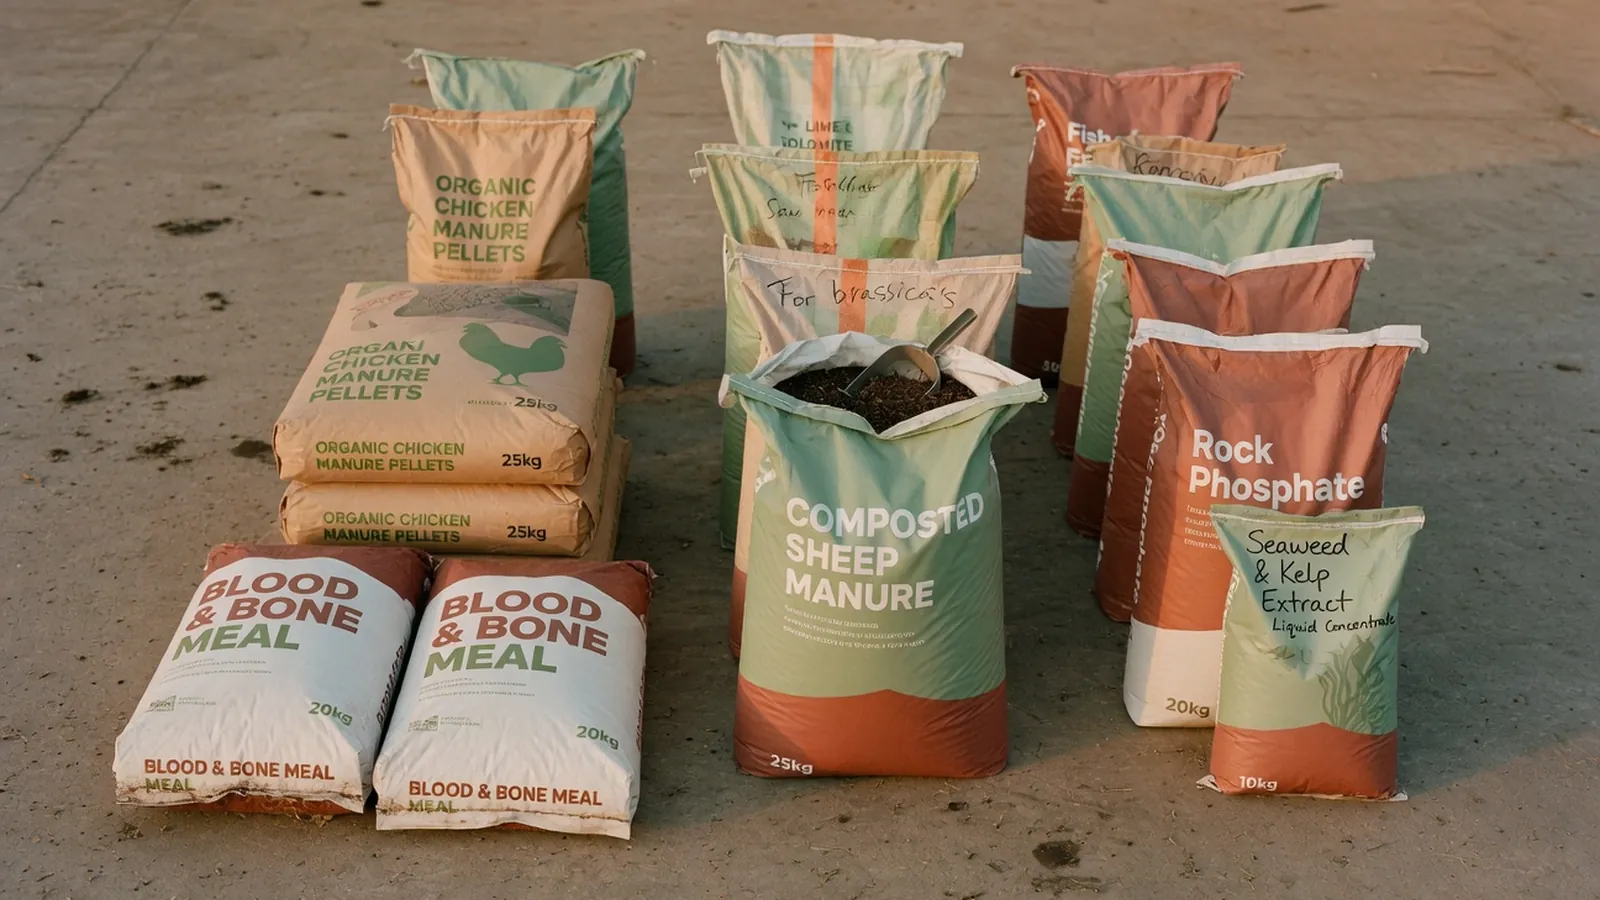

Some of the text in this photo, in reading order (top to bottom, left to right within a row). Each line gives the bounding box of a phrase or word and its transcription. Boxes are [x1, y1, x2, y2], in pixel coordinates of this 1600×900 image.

[1068, 121, 1111, 143] Fish
[436, 175, 536, 196] ORGANIC
[435, 197, 533, 218] CHICKEN
[434, 220, 529, 240] MANURE
[433, 242, 525, 263] PELLETS
[767, 276, 816, 308] For
[323, 353, 441, 373] CHICKEN
[316, 368, 430, 387] MANURE
[309, 385, 423, 403] PELLETS
[316, 441, 465, 456] ORGANIC CHICKEN
[1192, 429, 1274, 465] Rock
[316, 458, 455, 472] MANURE PELLETS
[502, 454, 542, 469] 25kg
[1188, 465, 1365, 509] Phosphate
[323, 511, 471, 527] ORGANIC CHICKEN
[786, 492, 984, 539] COMPOSTED
[324, 529, 460, 543] MANURE PELLETS
[507, 526, 546, 541] 25kg
[1246, 529, 1350, 555] Seaweed
[786, 533, 899, 576] SHEEP
[1254, 558, 1330, 592] & Kelp
[199, 572, 359, 606] BLOOD
[785, 568, 935, 611] MANURE
[440, 590, 602, 622] BLOOD
[1262, 588, 1353, 613] Extract
[185, 597, 363, 634] & BONE
[432, 616, 609, 657] & BONE
[1272, 617, 1318, 639] Liquid
[172, 623, 300, 662] MEAL
[423, 643, 558, 679] MEAL
[1165, 697, 1210, 718] 20kg
[576, 725, 619, 750] 20kg
[144, 758, 335, 780] BLOOD & BONE MEAL
[770, 754, 813, 775] 25kg
[145, 778, 197, 792] MEAL
[409, 781, 603, 806] BLOOD & BONE MEAL
[1239, 775, 1278, 792] 10kg
[409, 799, 460, 813] MEAL
